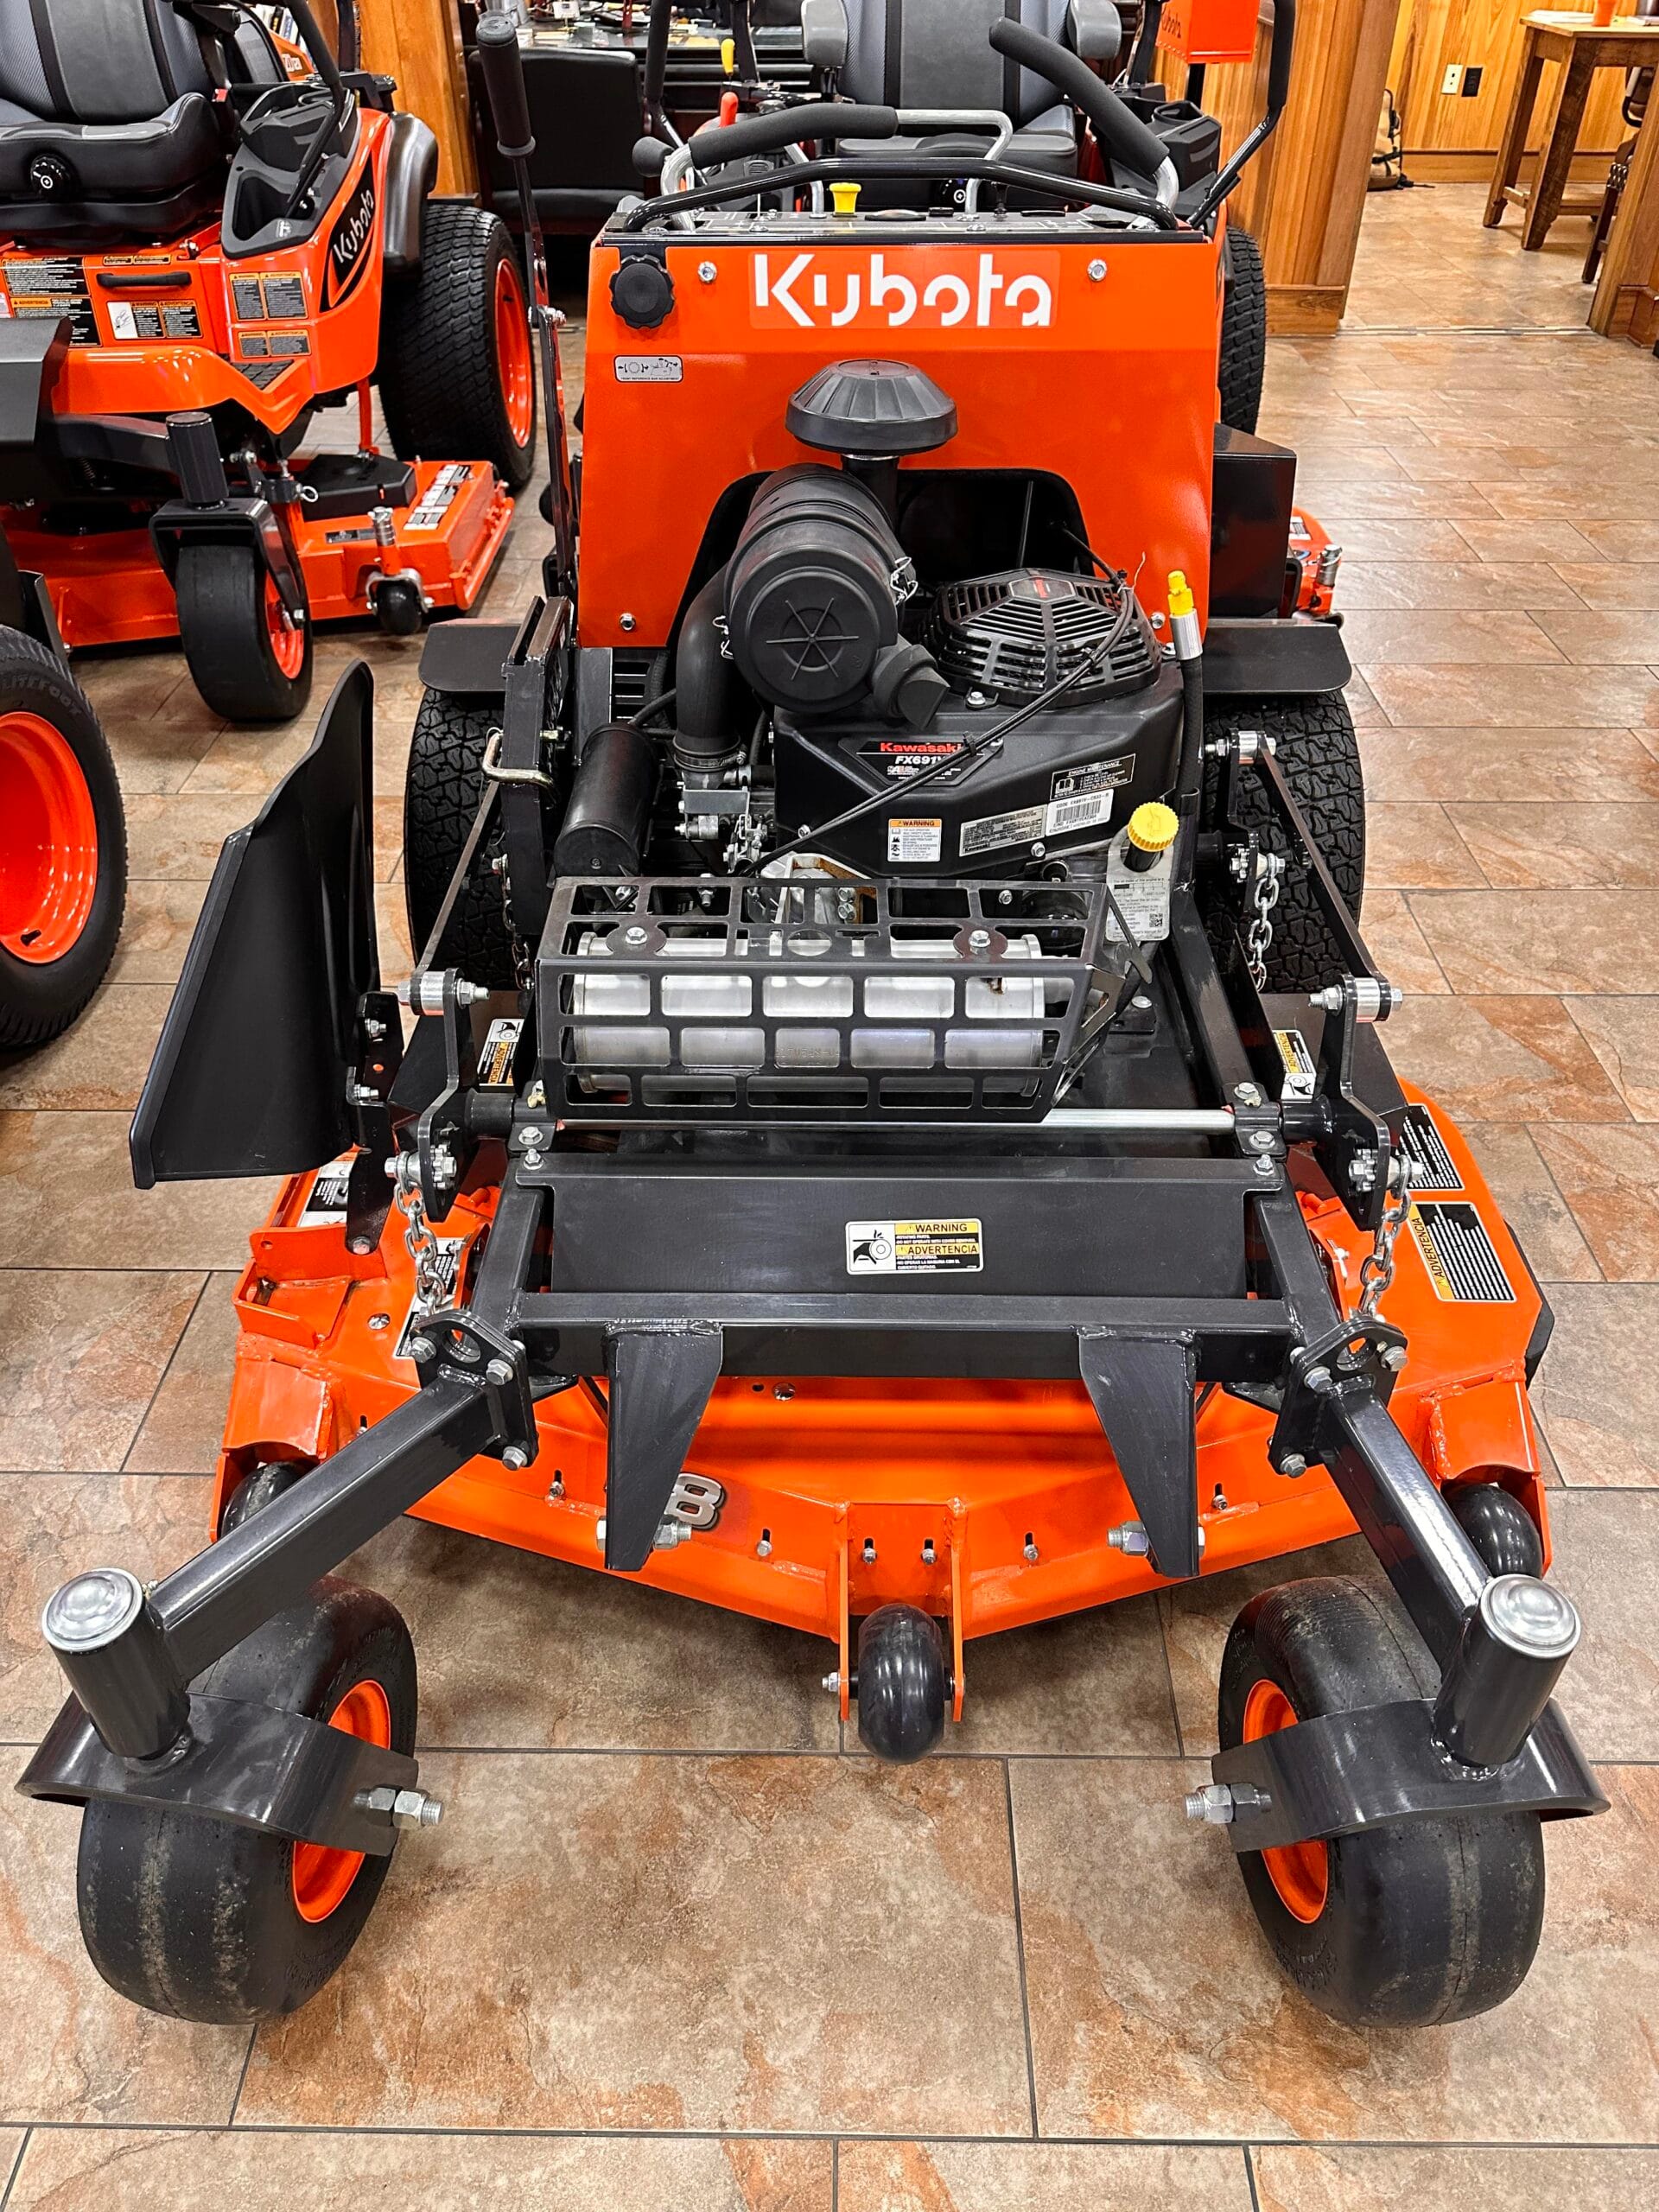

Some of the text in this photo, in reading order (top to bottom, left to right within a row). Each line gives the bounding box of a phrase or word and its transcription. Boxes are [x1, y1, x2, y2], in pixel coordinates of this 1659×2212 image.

[334, 189, 374, 263] Kubota
[754, 253, 1052, 327] Kubota
[880, 742, 963, 753] Kawasaki
[489, 1047, 505, 1083] ADVERTENCIA
[1279, 1033, 1296, 1067] ADVERTENCIA
[915, 1223, 968, 1233] WARNING
[908, 1244, 977, 1255] ADVERTENCIA
[1411, 1217, 1446, 1278] ADVERTENCIA
